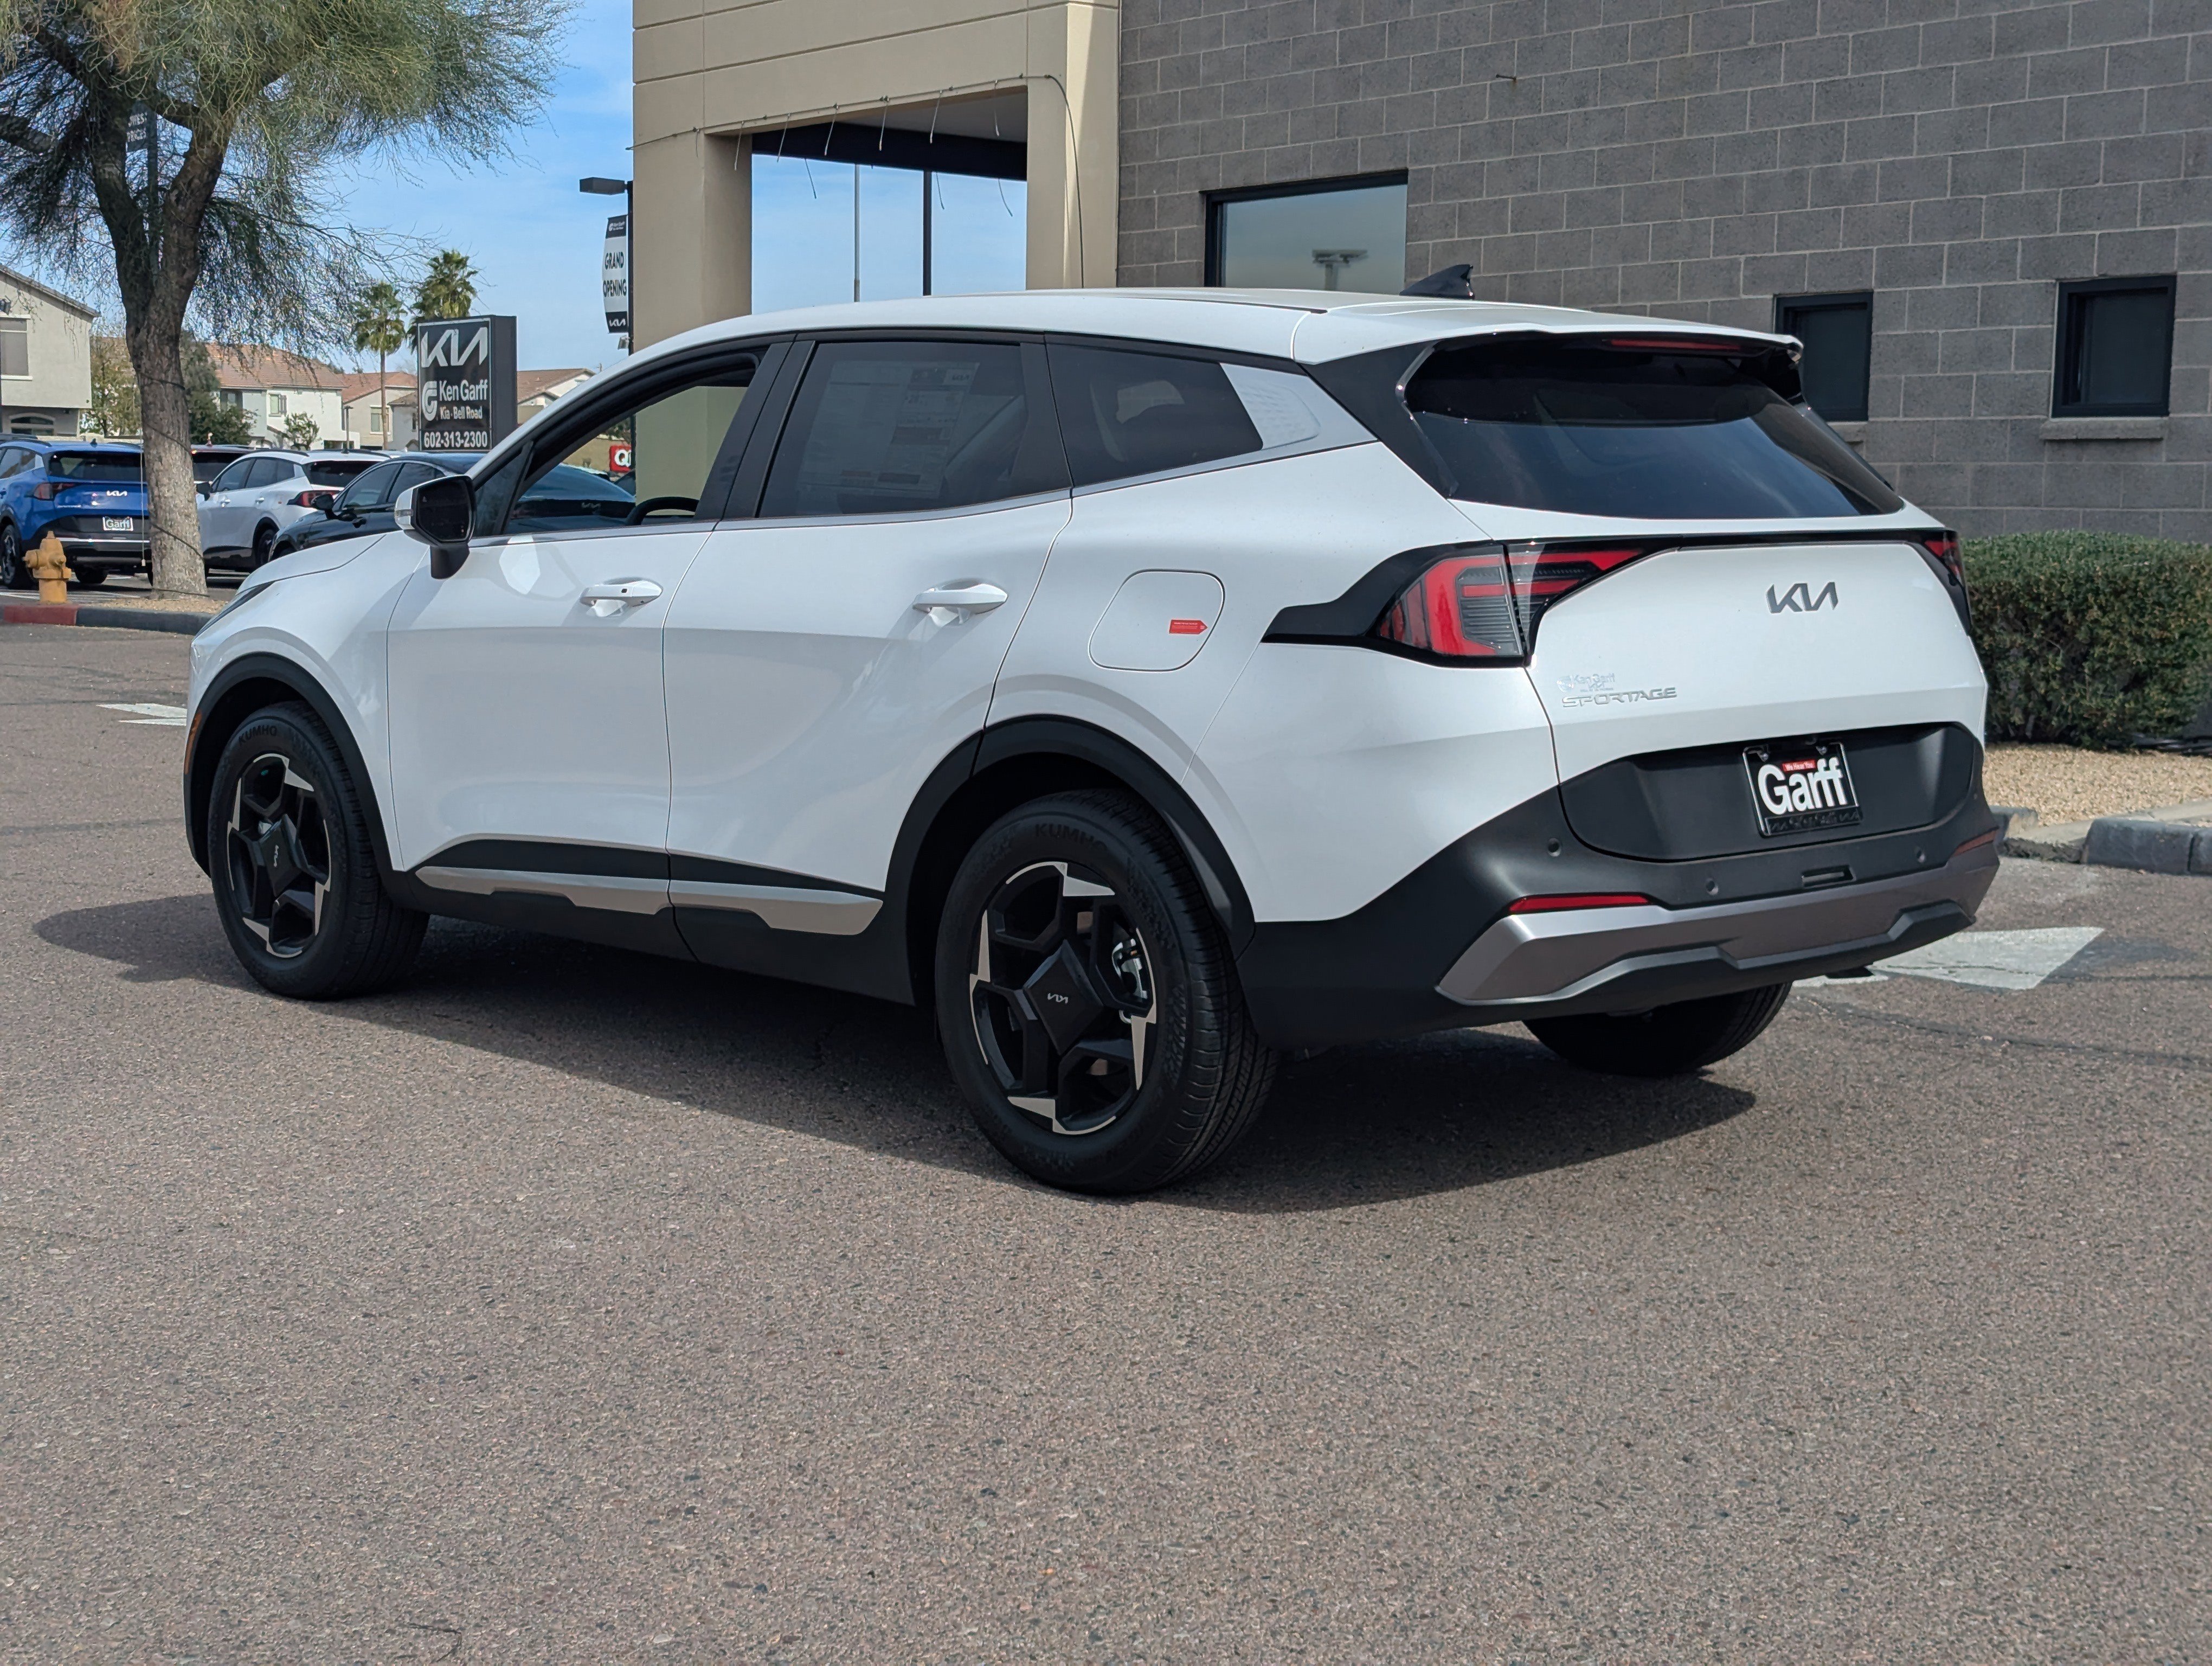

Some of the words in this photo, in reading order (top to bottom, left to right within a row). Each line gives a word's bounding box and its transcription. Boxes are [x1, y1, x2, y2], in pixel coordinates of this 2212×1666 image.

[605, 251, 624, 270] GRAND
[602, 279, 627, 297] OPENING
[421, 326, 488, 368] KIA
[439, 380, 459, 401] Ken
[460, 379, 488, 401] Garff
[440, 406, 450, 420] Kia
[453, 406, 465, 420] Bell
[466, 406, 483, 420] Road
[106, 519, 130, 528] Garff
[1765, 581, 1838, 614] KIA
[1561, 687, 1677, 708] SPORTAGE
[239, 725, 278, 746] KUMHO
[1758, 757, 1848, 815] Garff
